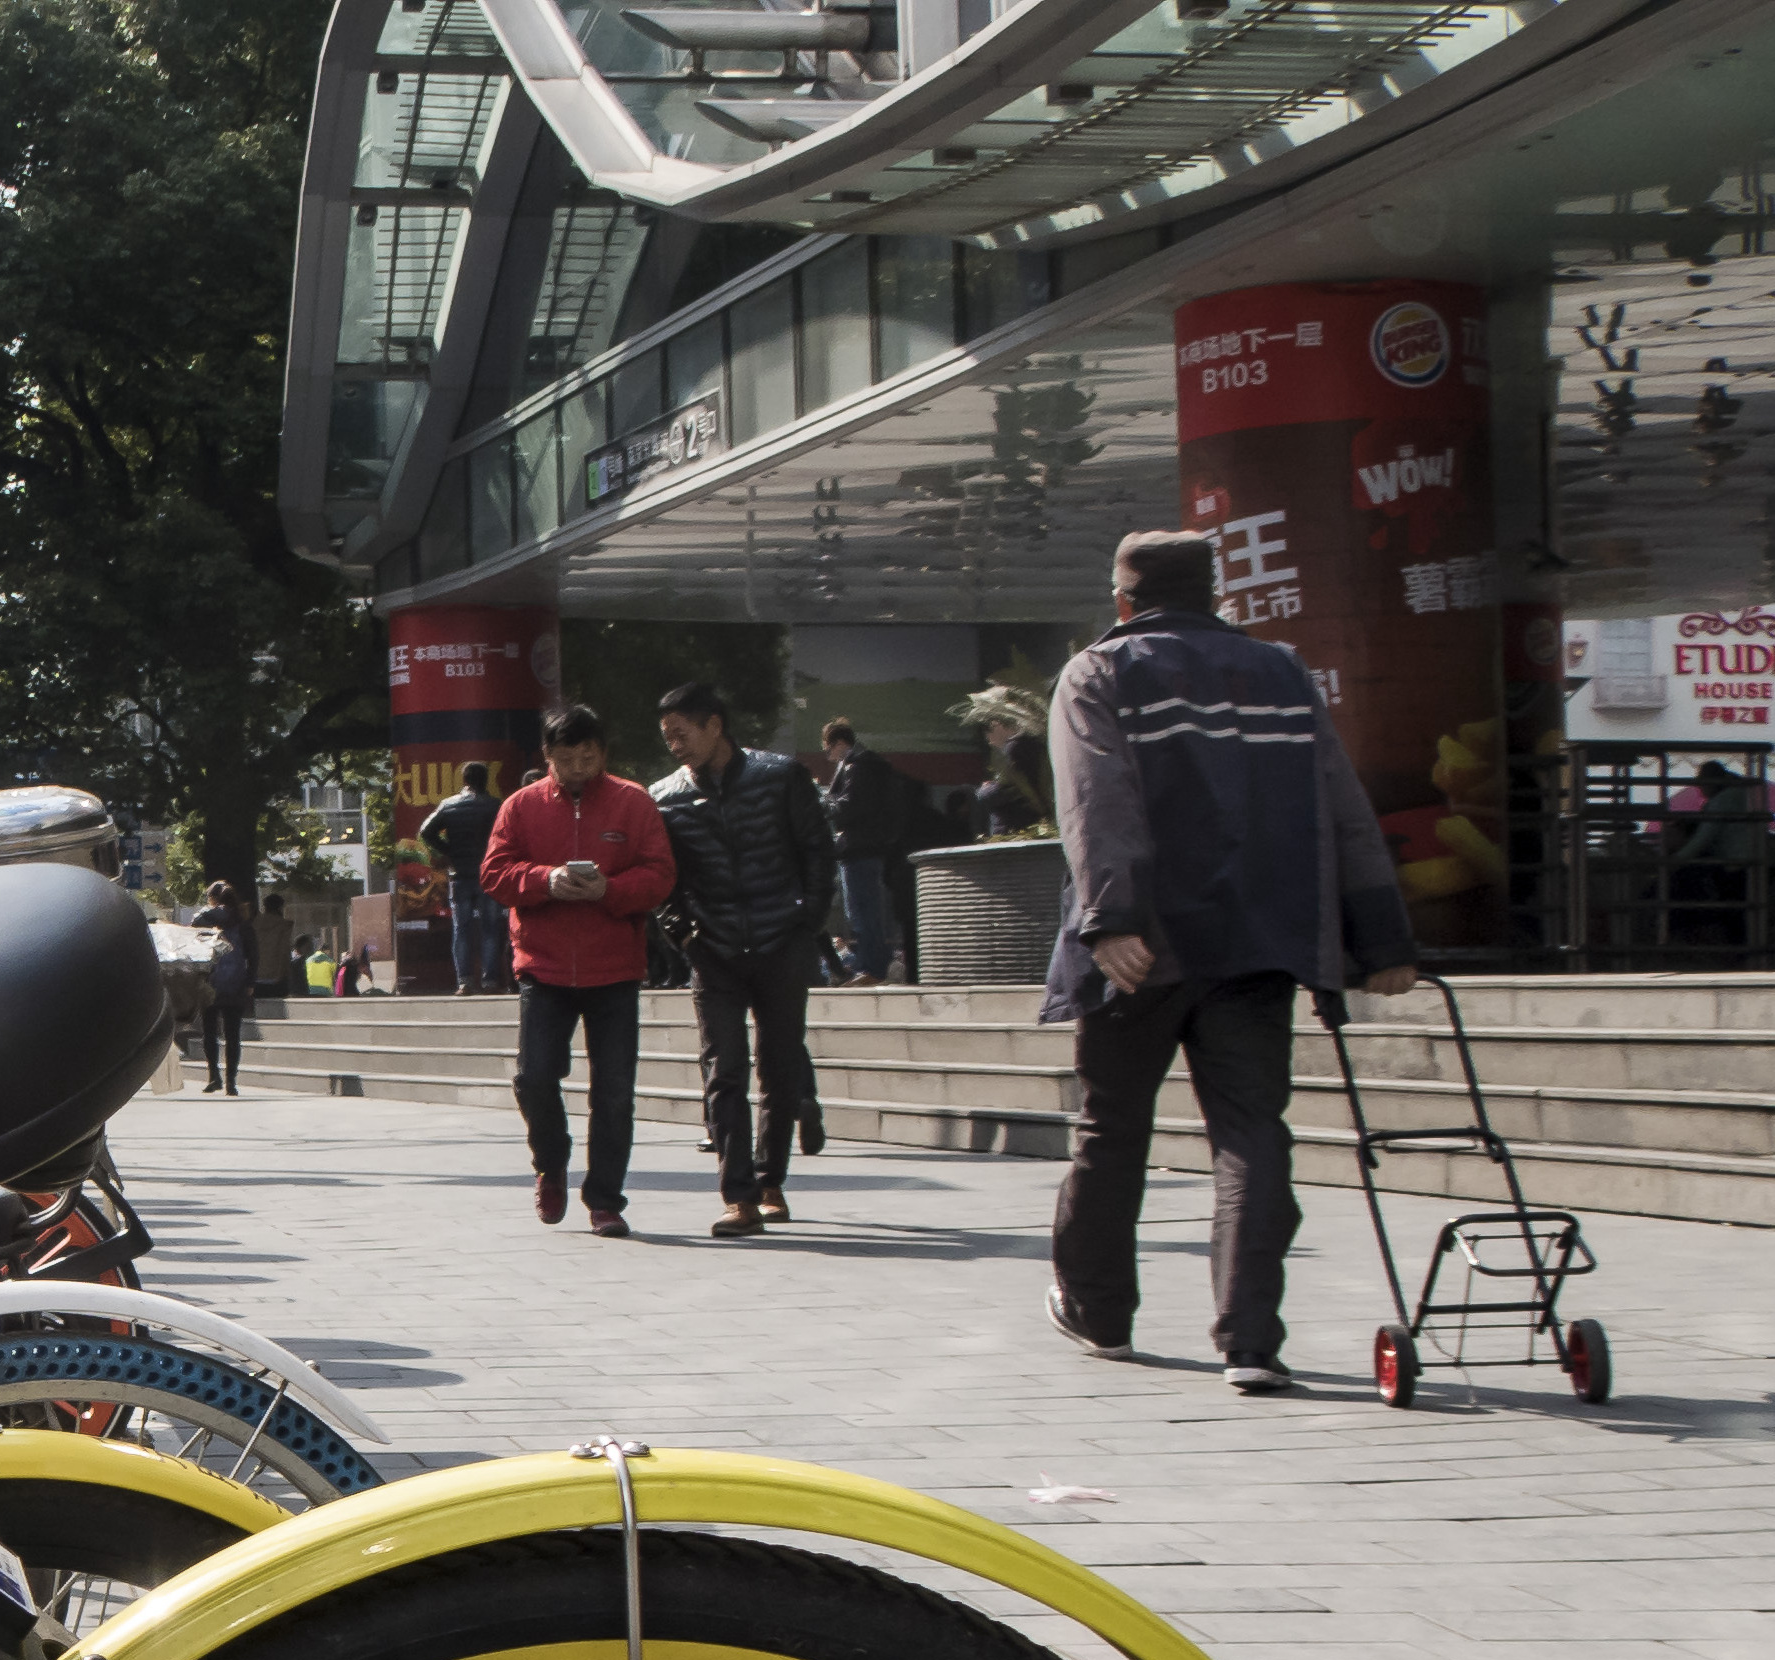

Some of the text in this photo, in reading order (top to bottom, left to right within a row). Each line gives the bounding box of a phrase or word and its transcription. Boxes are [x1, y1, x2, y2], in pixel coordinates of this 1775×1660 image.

[1201, 360, 1269, 394] B103
[1212, 508, 1299, 597] 王
[444, 662, 486, 677] B103
[1674, 643, 1775, 675] ETUD
[1693, 681, 1774, 700] HOUSE
